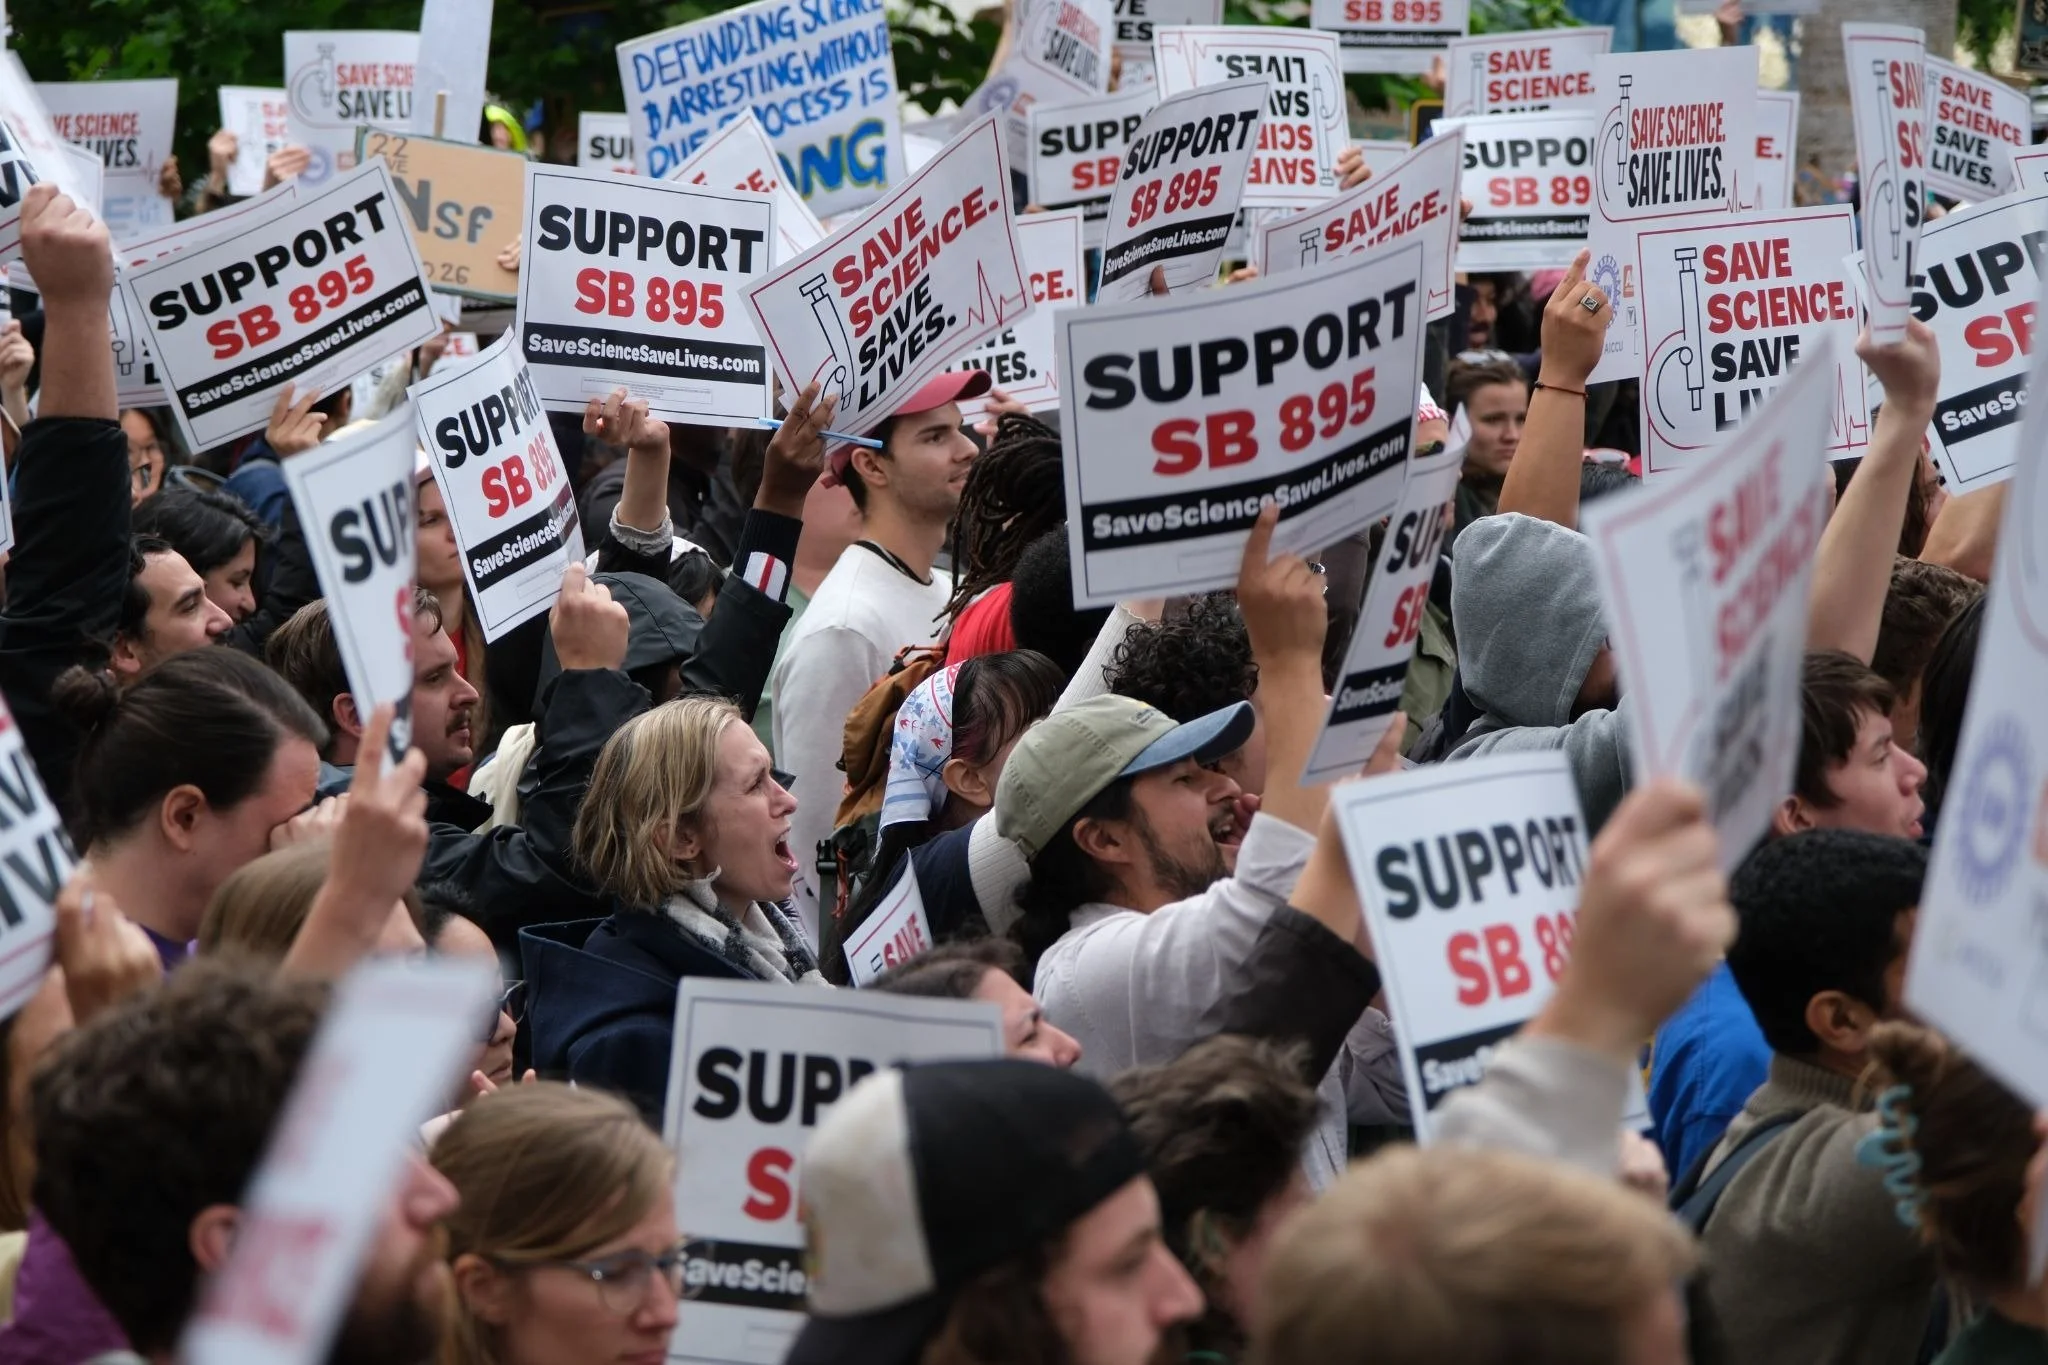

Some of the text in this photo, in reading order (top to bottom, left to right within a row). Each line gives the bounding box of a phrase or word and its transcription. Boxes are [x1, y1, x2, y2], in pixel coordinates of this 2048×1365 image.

[1345, 0, 1442, 23] SB 895
[336, 64, 378, 88] SAVE
[633, 6, 797, 93] DEFUNDING
[1488, 48, 1552, 74] SAVE
[338, 90, 394, 119] SAVE
[665, 52, 804, 129] ARRESTING
[859, 68, 888, 107] IS
[1269, 90, 1310, 117] SAV
[1488, 72, 1596, 103] SCIENCE.
[1941, 76, 1992, 110] SAVE
[75, 111, 142, 137] SCIENCE.
[1040, 114, 1143, 157] SUPP
[1122, 109, 1258, 181] SUPPORT
[1463, 137, 1595, 169] SUPPO
[1630, 107, 1665, 150] SAVE
[1666, 102, 1726, 148] SCIENCE.
[1935, 126, 1989, 158] SAVE
[1072, 156, 1120, 190] SB
[1127, 166, 1221, 228] SB 895
[1248, 158, 1317, 185] SAVE
[1488, 176, 1591, 207] SB 89
[1627, 151, 1672, 208] SAVE
[1674, 146, 1726, 202] LIVES.
[1931, 149, 1996, 188] LIVES.
[537, 204, 764, 274] SUPPORT
[832, 196, 927, 297] SAVE
[1324, 184, 1400, 252] SAVE
[149, 192, 385, 330] SUPPORT
[849, 186, 999, 338] SCIENCE.
[1105, 225, 1228, 276] SaveScienceSaveLives.com
[1703, 238, 1792, 285] SAVE
[205, 254, 375, 360] SB 895
[574, 268, 725, 329] SB 895
[858, 273, 932, 377] SAVE
[1707, 281, 1854, 334] SCIENCE.
[187, 287, 421, 410] SaveScienceSaveLives.com
[528, 333, 760, 374] SaveScienceSaveLives.com
[858, 304, 957, 412] LIVES.
[1084, 280, 1416, 410] SUPPORT
[436, 364, 541, 469] SUPPORT
[1151, 366, 1376, 477] SB 895
[481, 432, 557, 518] SB 895
[1092, 434, 1405, 538] SaveScienceSaveLives.com
[1376, 816, 1583, 920] SUPPORT
[1446, 922, 1531, 1008] SB
